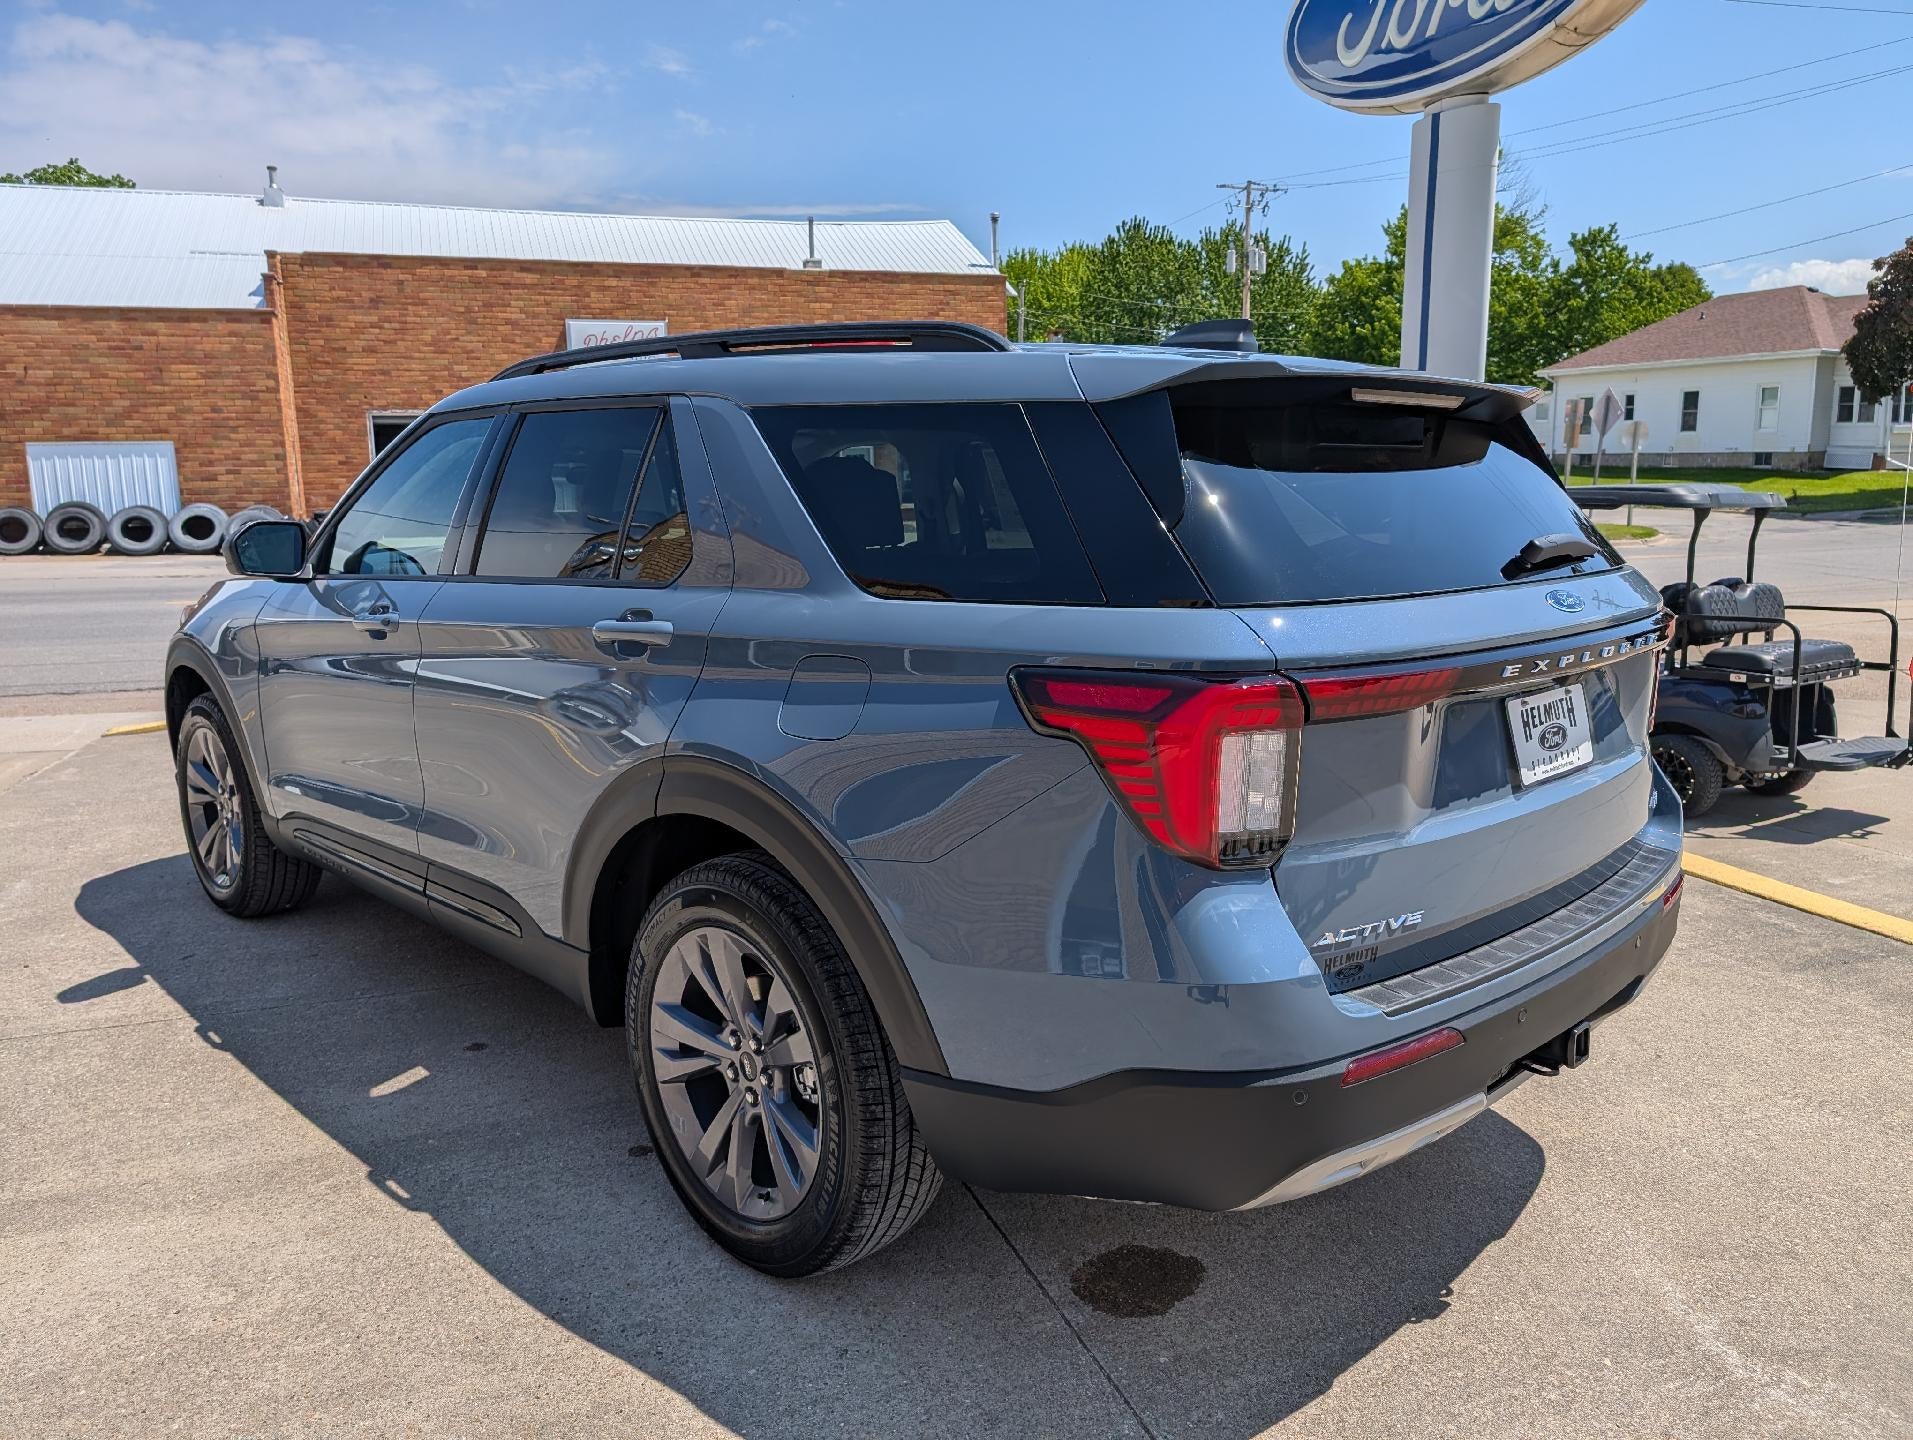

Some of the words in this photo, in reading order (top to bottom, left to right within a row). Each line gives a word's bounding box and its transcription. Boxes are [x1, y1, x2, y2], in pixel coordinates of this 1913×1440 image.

[1502, 633, 1659, 678] EXPLORER
[1520, 696, 1577, 743] HELMUTH
[1542, 725, 1565, 749] Ford
[1310, 910, 1425, 947] ACTIVE
[1323, 946, 1379, 975] HELMUTH
